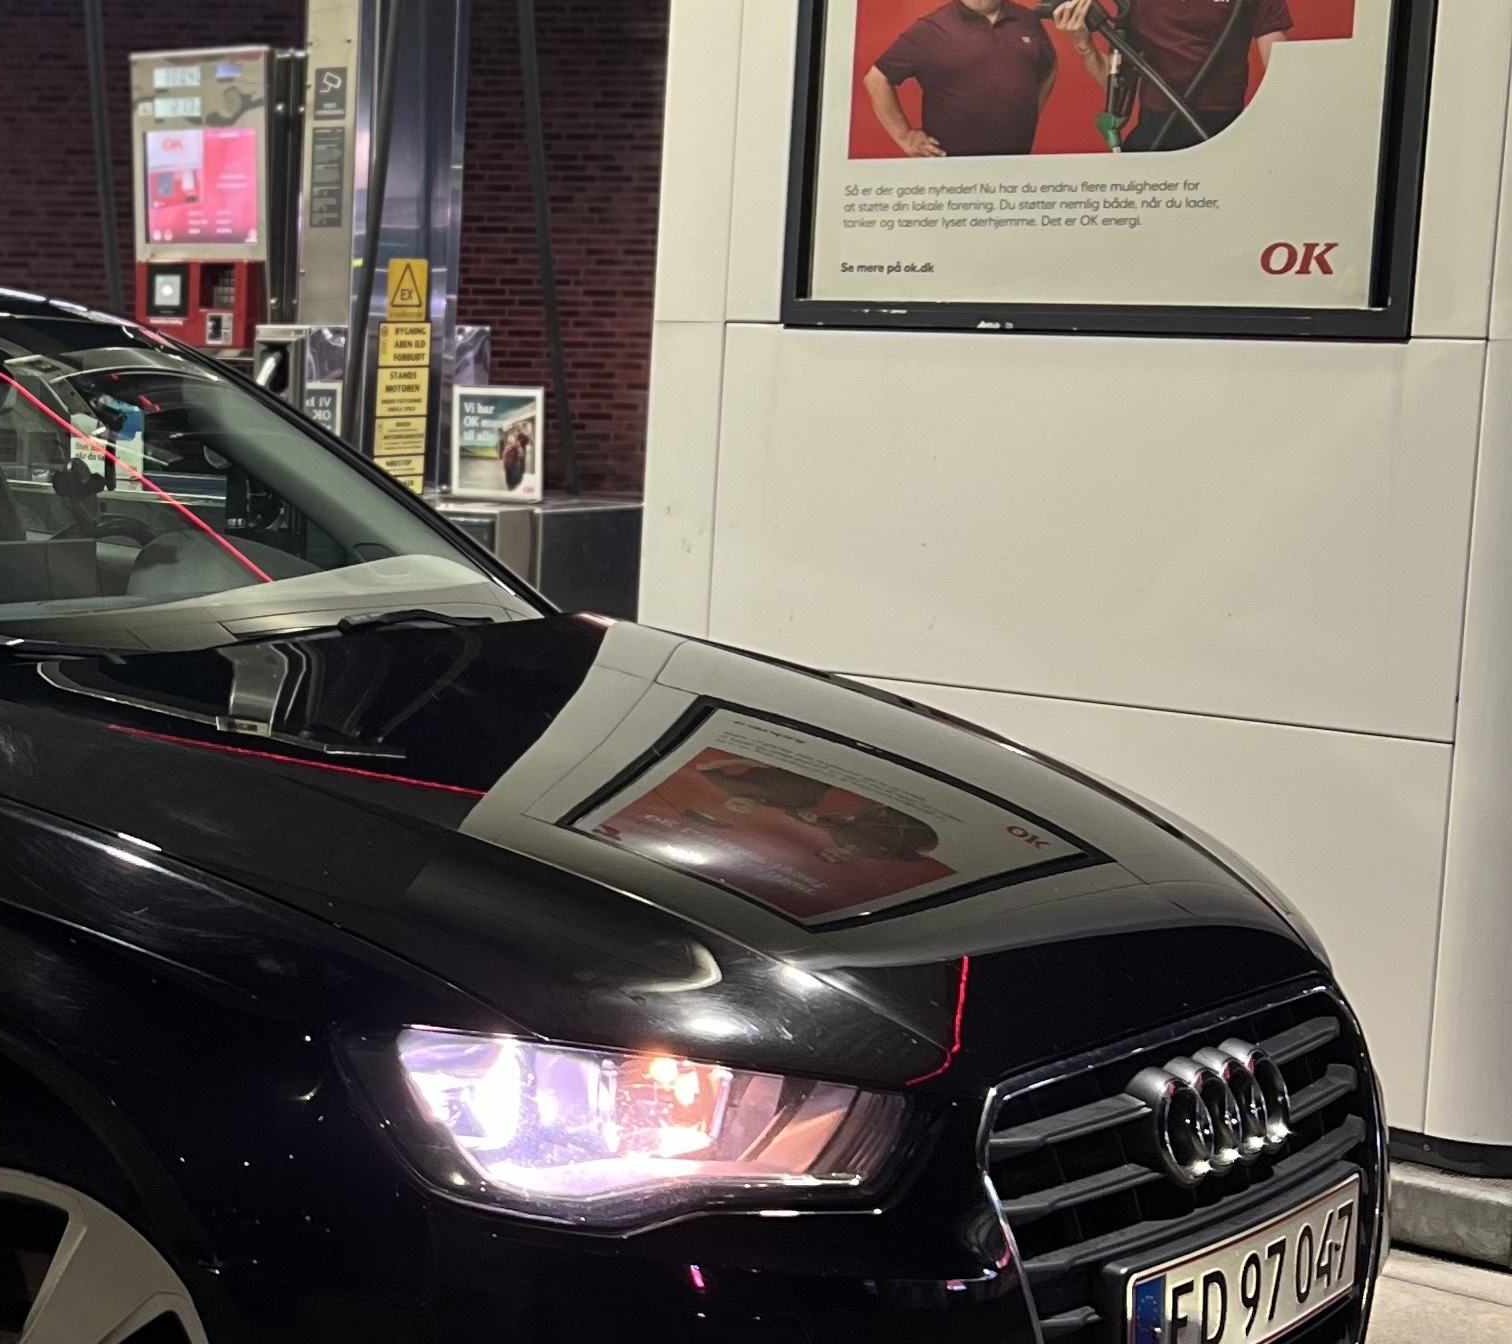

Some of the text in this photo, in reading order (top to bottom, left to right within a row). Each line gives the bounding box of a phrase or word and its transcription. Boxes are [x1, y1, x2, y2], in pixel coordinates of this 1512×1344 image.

[844, 179, 1200, 198] Så er der gode nyheder! Nu har du endnu flere muligheder for
[844, 196, 1220, 213] at støtte din lokale forening. Du støtter nemlig både, når du lader,
[843, 215, 1141, 230] tanker og tænder lyset derhjemme. Det er OK energi.
[1260, 241, 1339, 275] OK
[841, 261, 935, 274] Se mere på ok.dk
[400, 287, 414, 301] EX
[393, 352, 425, 362] FORBUDT
[385, 384, 420, 393] MOTOREN
[463, 402, 495, 414] Vi har
[463, 416, 480, 427] OK
[1240, 1235, 1287, 1338] 97
[1295, 1199, 1354, 1305] 047
